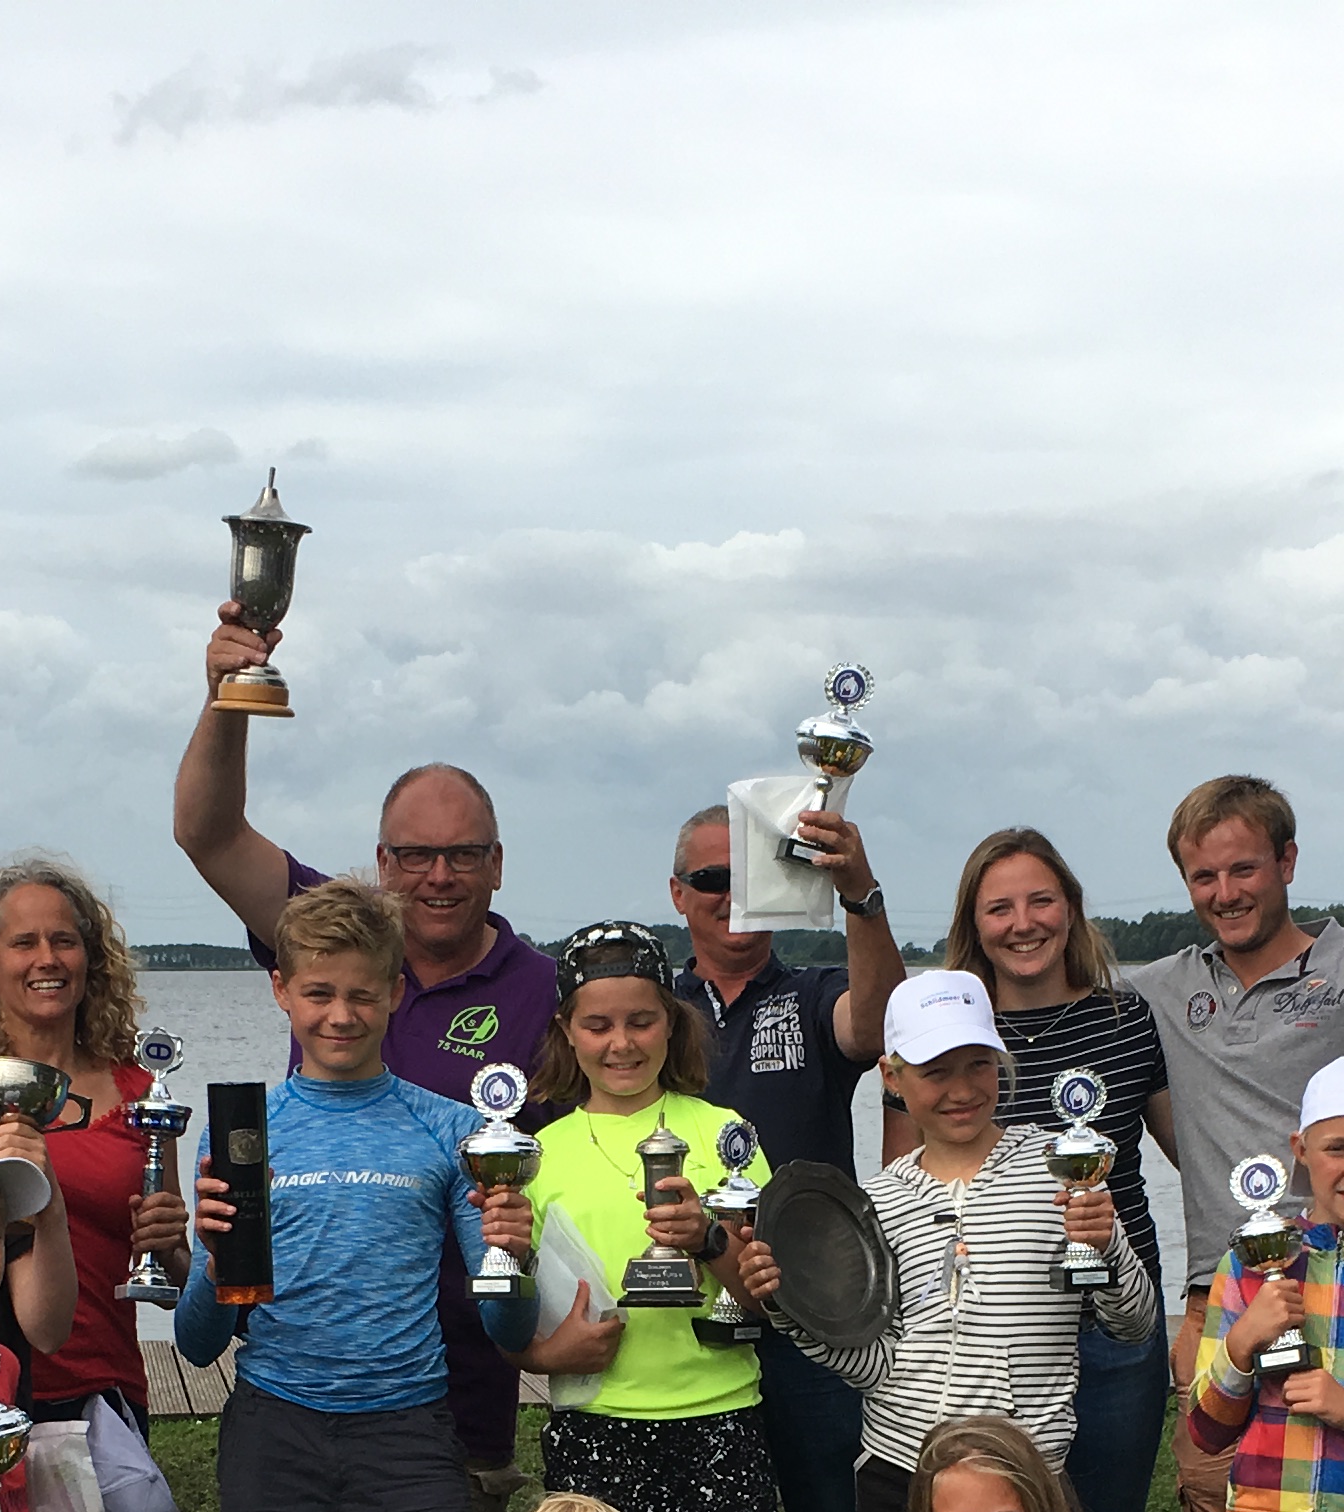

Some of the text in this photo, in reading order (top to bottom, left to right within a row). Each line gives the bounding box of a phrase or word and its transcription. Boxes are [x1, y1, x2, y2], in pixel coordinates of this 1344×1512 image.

[751, 1029, 804, 1046] UNITED
[437, 1039, 486, 1061] 75 JAAR
[750, 1044, 783, 1061] SUPPLY
